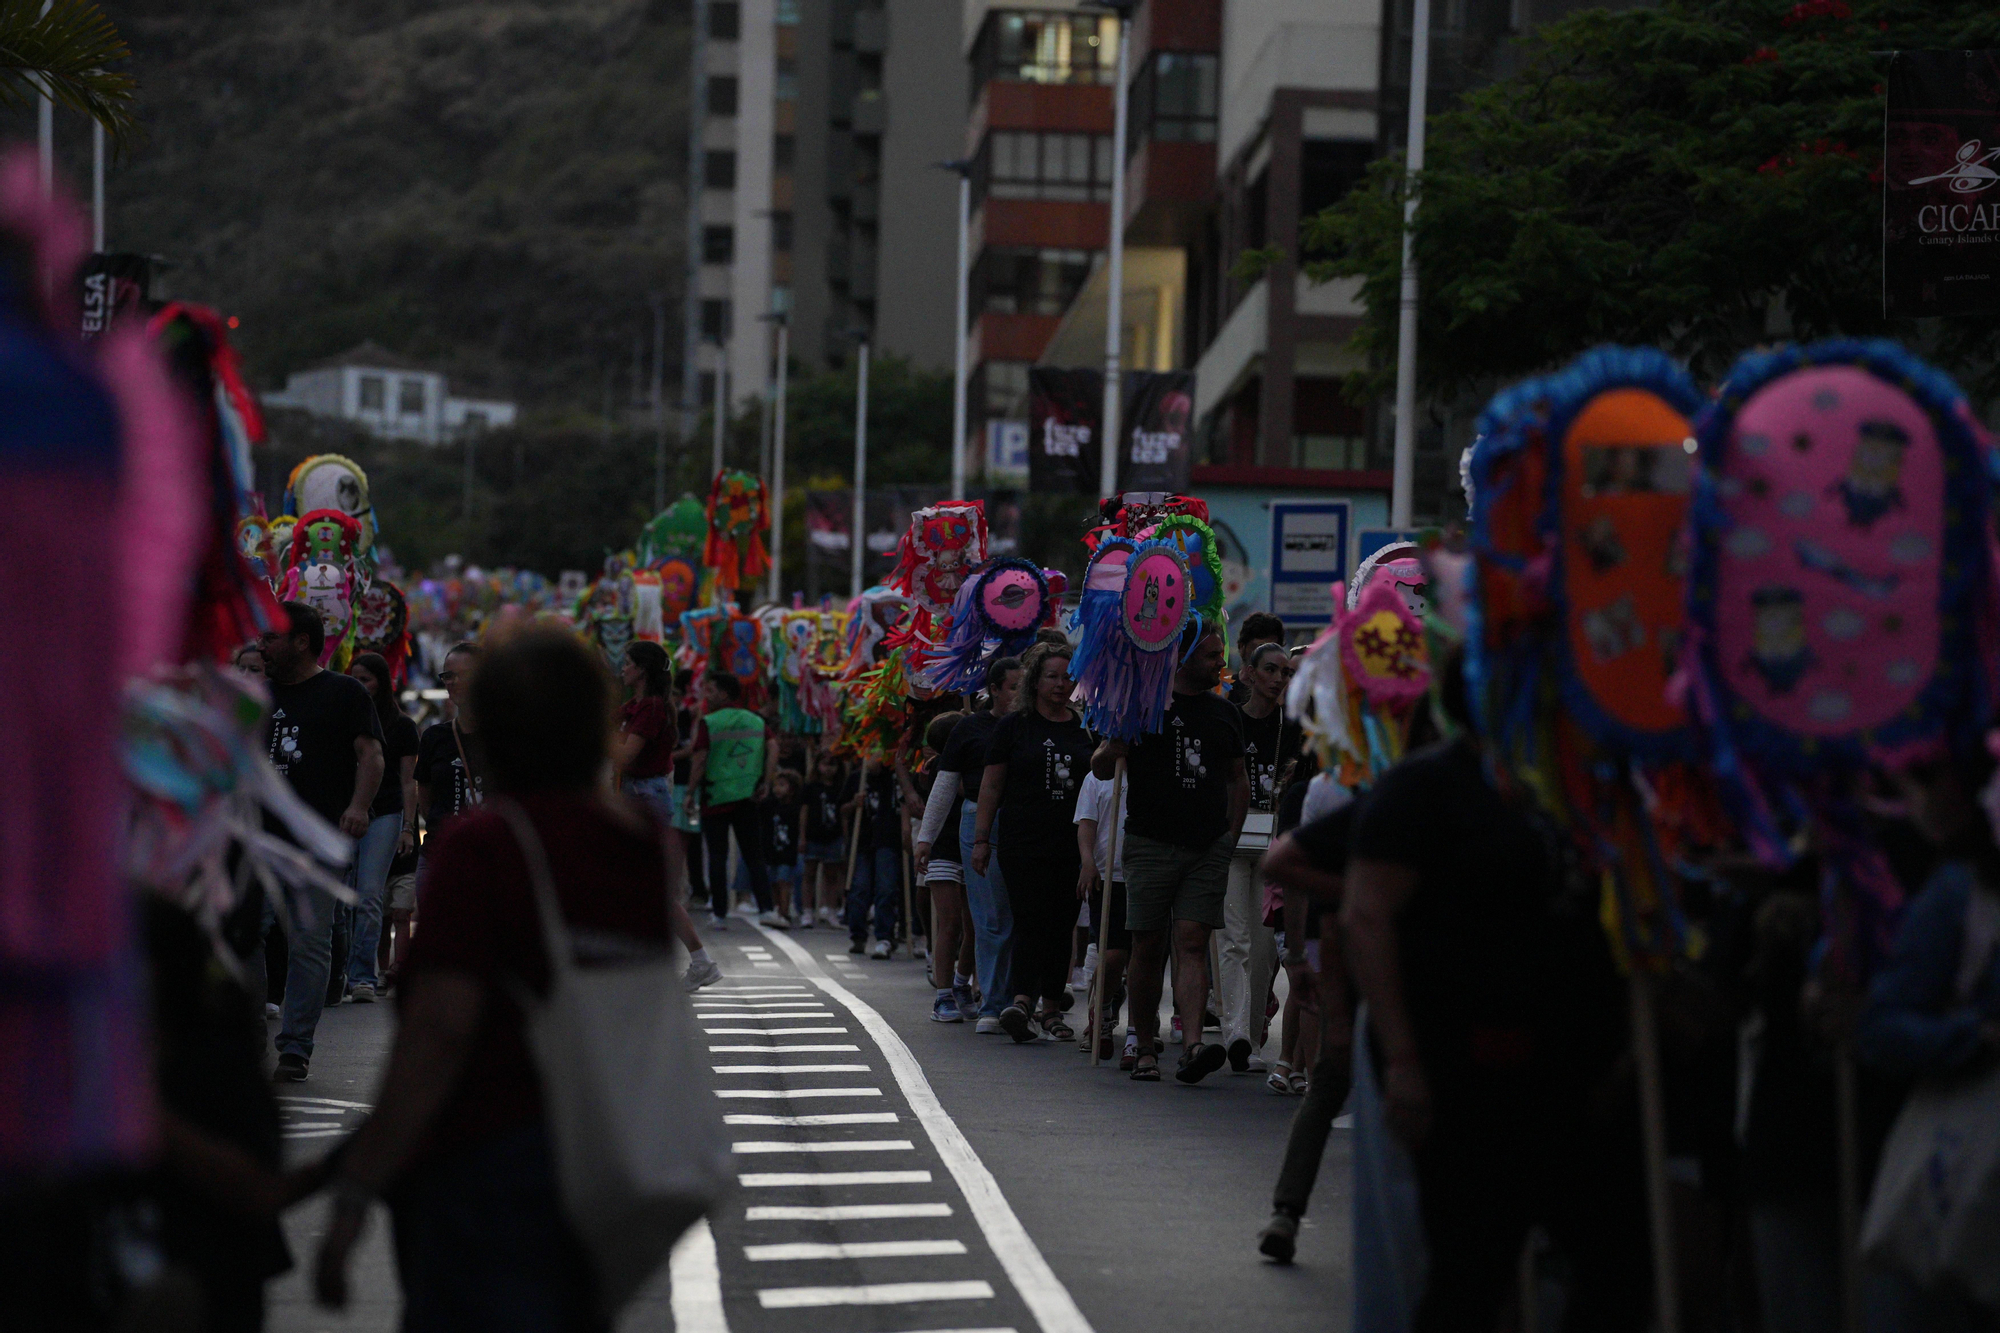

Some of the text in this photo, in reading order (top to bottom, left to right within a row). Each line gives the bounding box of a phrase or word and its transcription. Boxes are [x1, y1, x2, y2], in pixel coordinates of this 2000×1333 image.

[1919, 236, 1954, 246] Canary
[1958, 234, 1992, 243] Islands
[268, 721, 280, 764] PANDORGA
